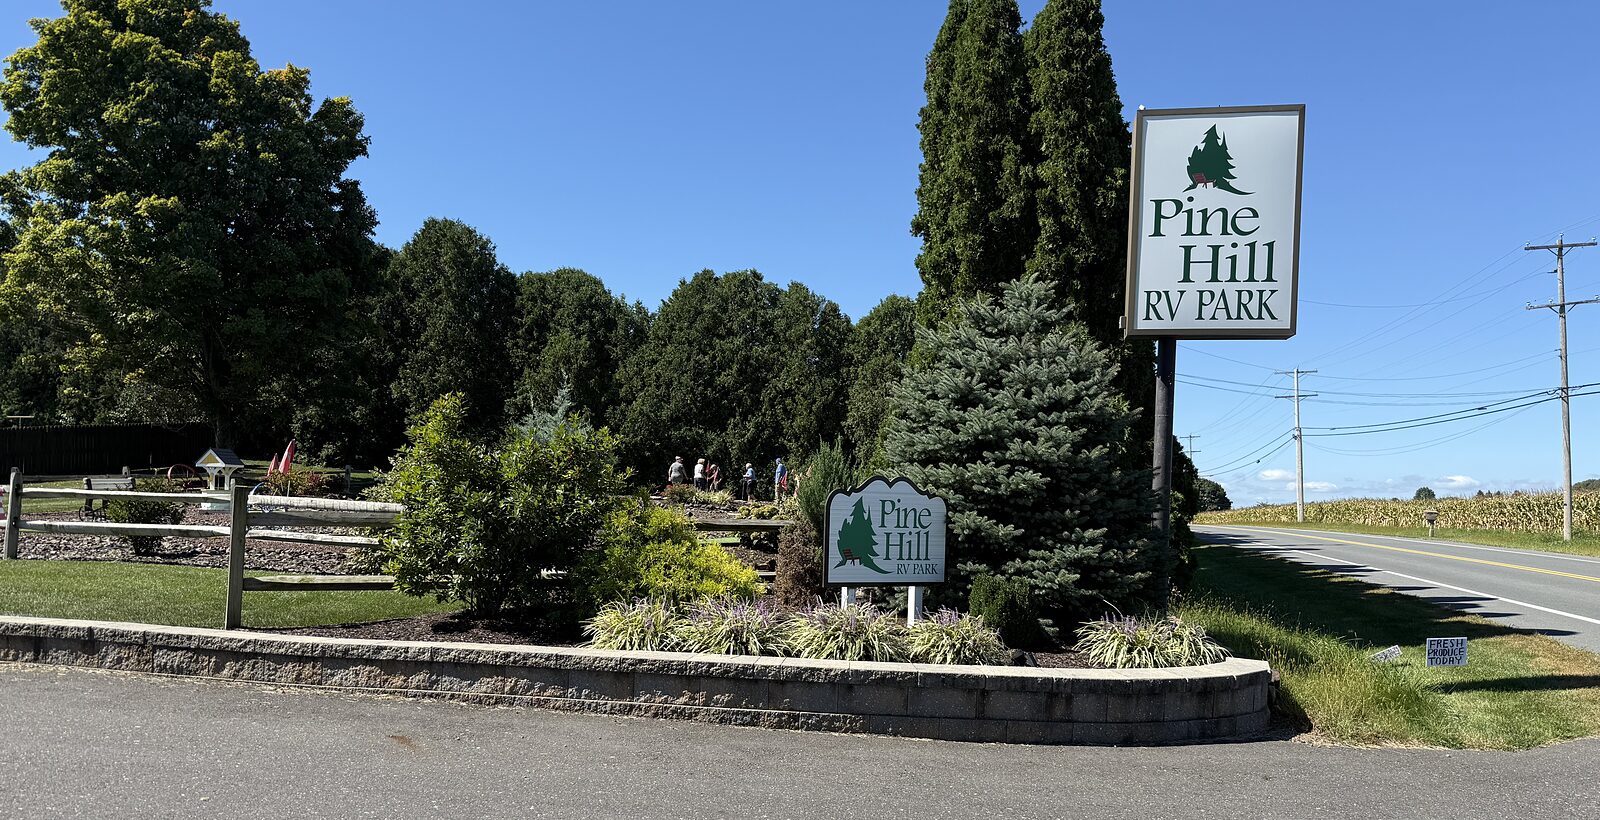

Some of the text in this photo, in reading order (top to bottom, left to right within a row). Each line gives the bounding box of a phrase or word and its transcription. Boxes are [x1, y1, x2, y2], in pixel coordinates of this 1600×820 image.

[1148, 196, 1260, 237] Pine
[1178, 240, 1278, 283] Hill
[1142, 288, 1279, 322] RV PARK
[878, 498, 932, 529] Pine
[883, 530, 930, 561] Hill
[897, 563, 938, 575] RV PARK
[1427, 647, 1464, 657] PRODUCE
[1429, 639, 1463, 648] FRESH
[1428, 657, 1462, 665] TODAY
